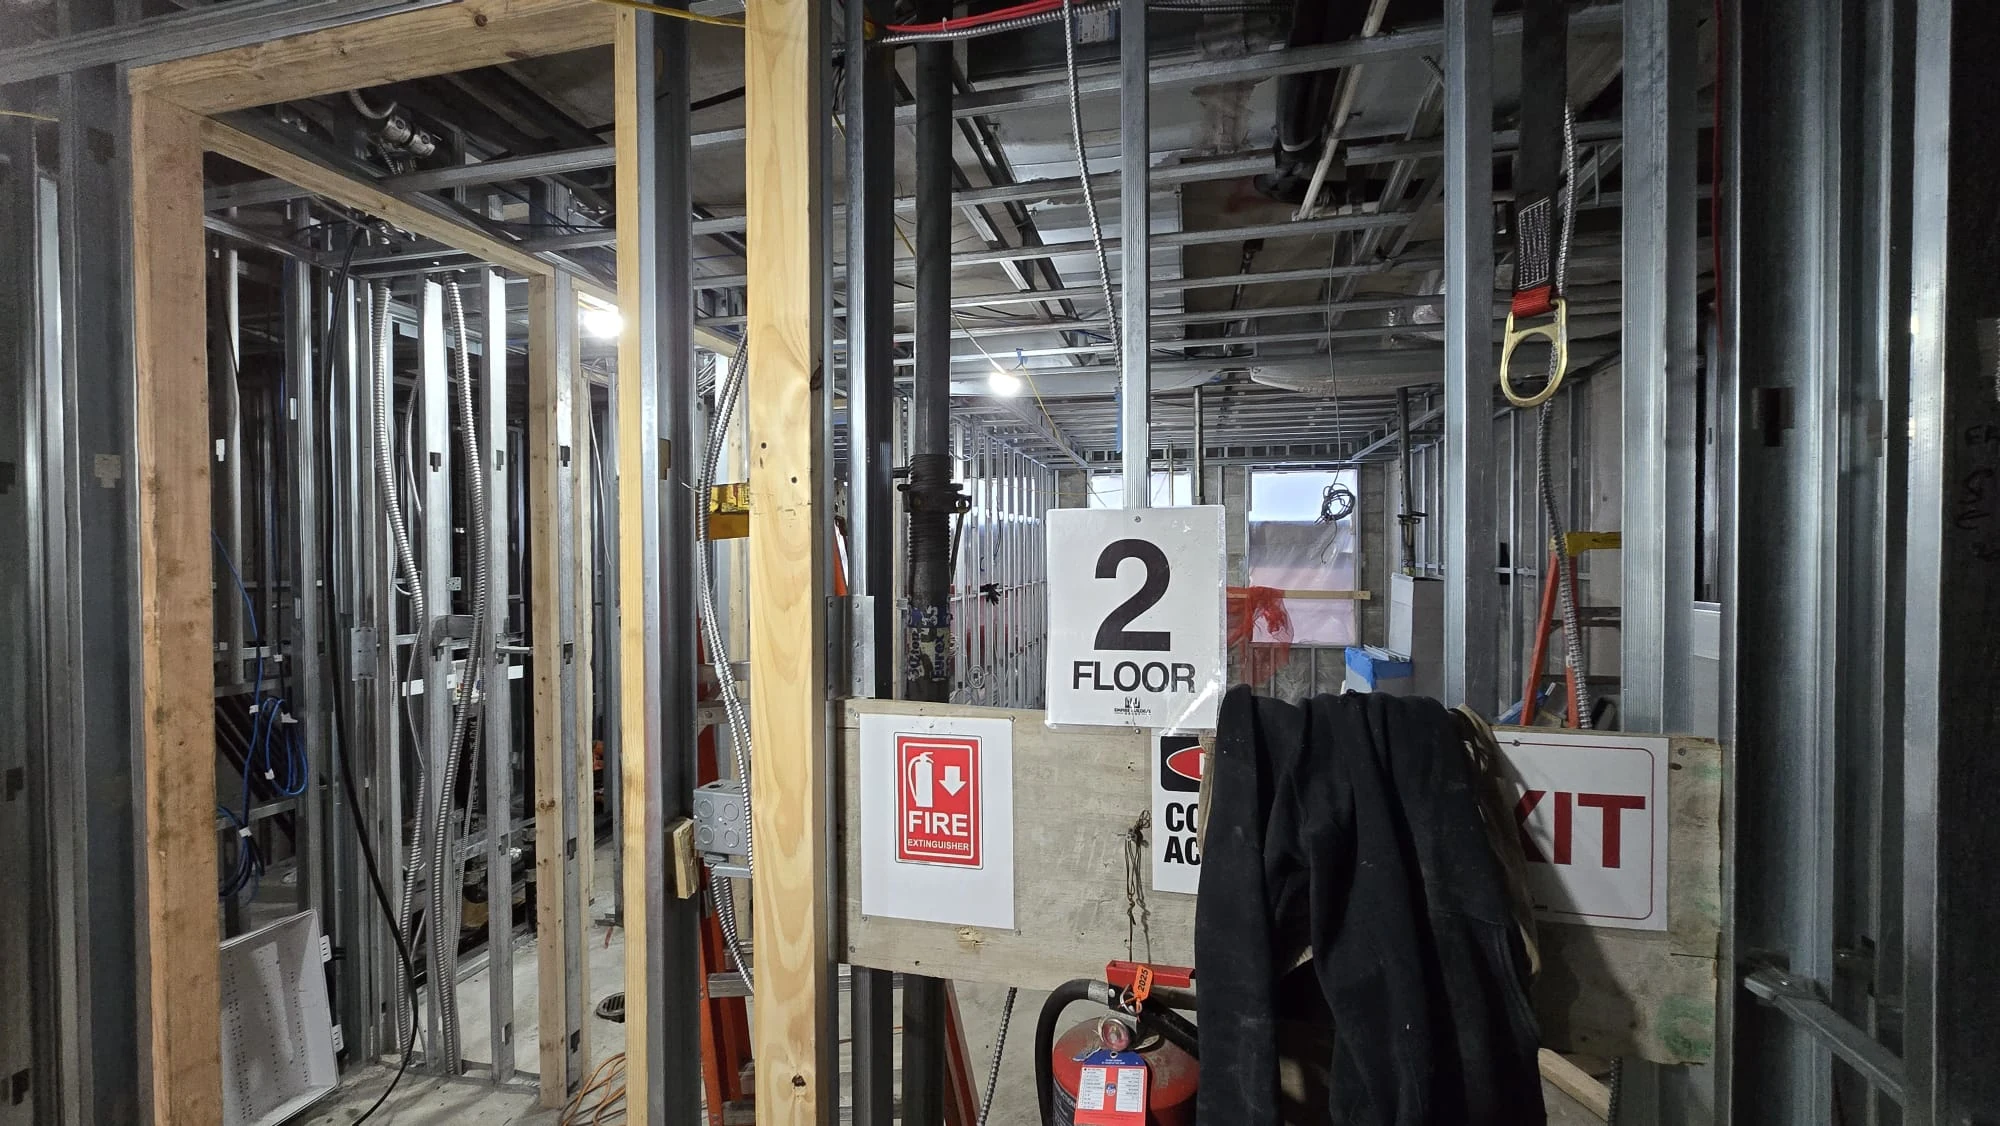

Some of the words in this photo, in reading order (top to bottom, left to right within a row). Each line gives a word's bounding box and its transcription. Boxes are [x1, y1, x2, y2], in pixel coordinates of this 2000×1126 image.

[1094, 538, 1171, 651] 2
[1073, 660, 1196, 694] FLOOR
[908, 810, 969, 837] FIRE
[1514, 789, 1646, 869] XIT
[907, 839, 970, 852] EXTINGUISHER
[1163, 836, 1201, 866] AC
[1137, 968, 1149, 992] 2025
